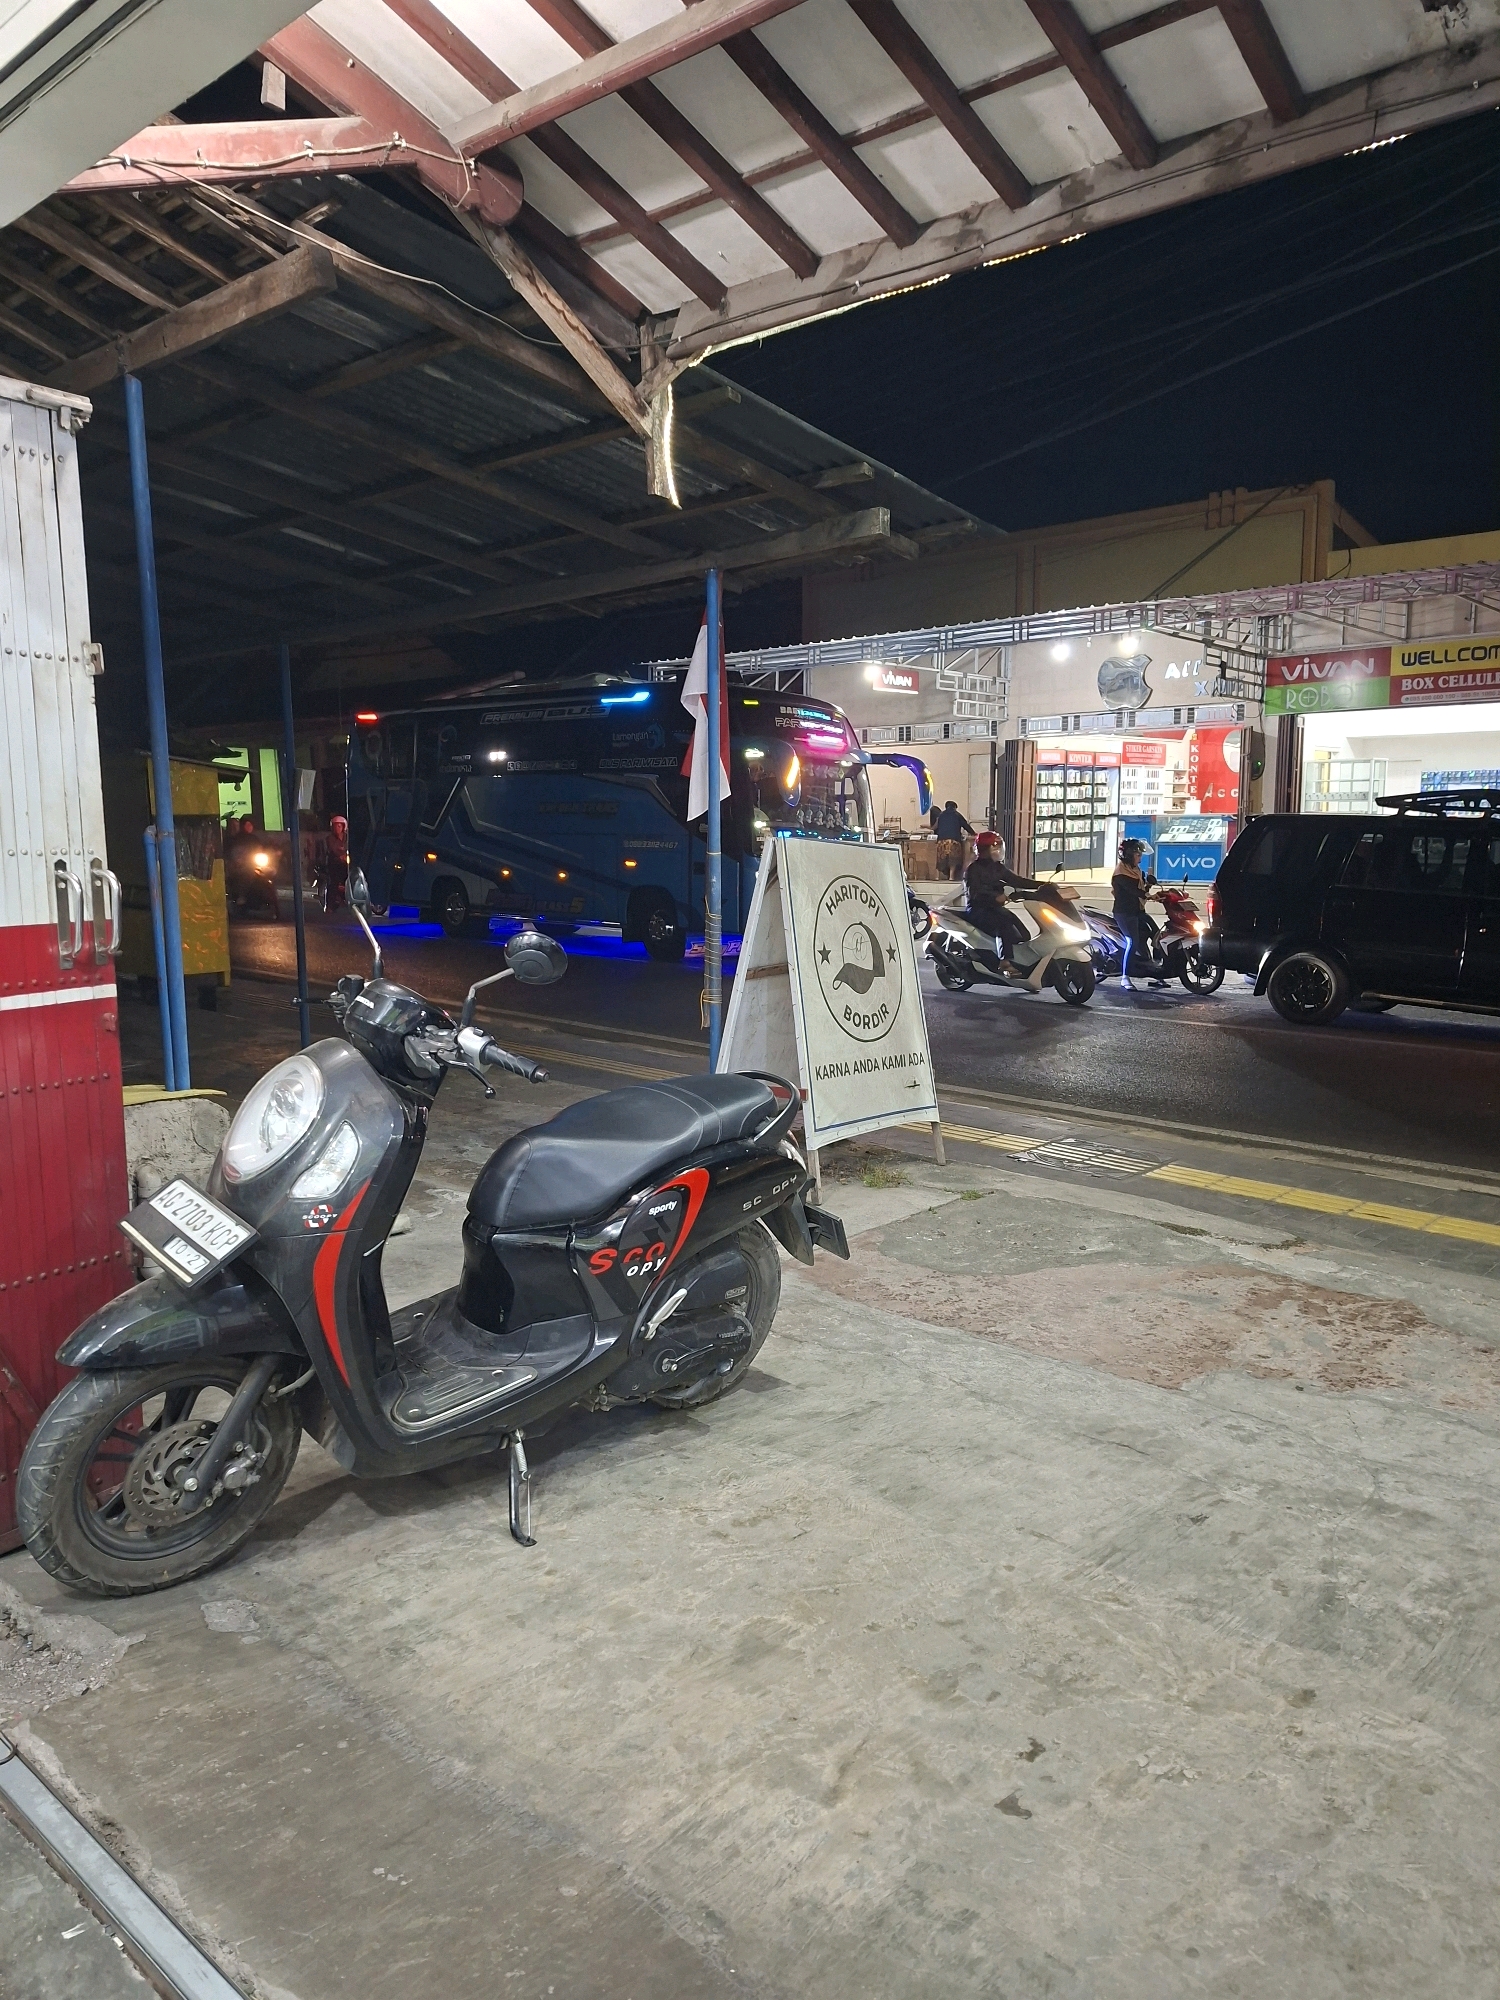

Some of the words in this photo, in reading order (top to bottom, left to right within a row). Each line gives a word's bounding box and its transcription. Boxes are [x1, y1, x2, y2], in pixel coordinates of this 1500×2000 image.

[1401, 676, 1435, 691] BOX
[1069, 754, 1093, 763] KONTER
[825, 884, 881, 918] HARITOPI
[843, 1002, 890, 1031] BORDIR
[815, 1063, 851, 1081] KARNA
[852, 1059, 881, 1077] ANDA
[882, 1055, 908, 1072] KAMI
[908, 1051, 926, 1067] ADA
[648, 1199, 678, 1217] sporty
[171, 1198, 215, 1233] 2703
[201, 1221, 241, 1252] KCP
